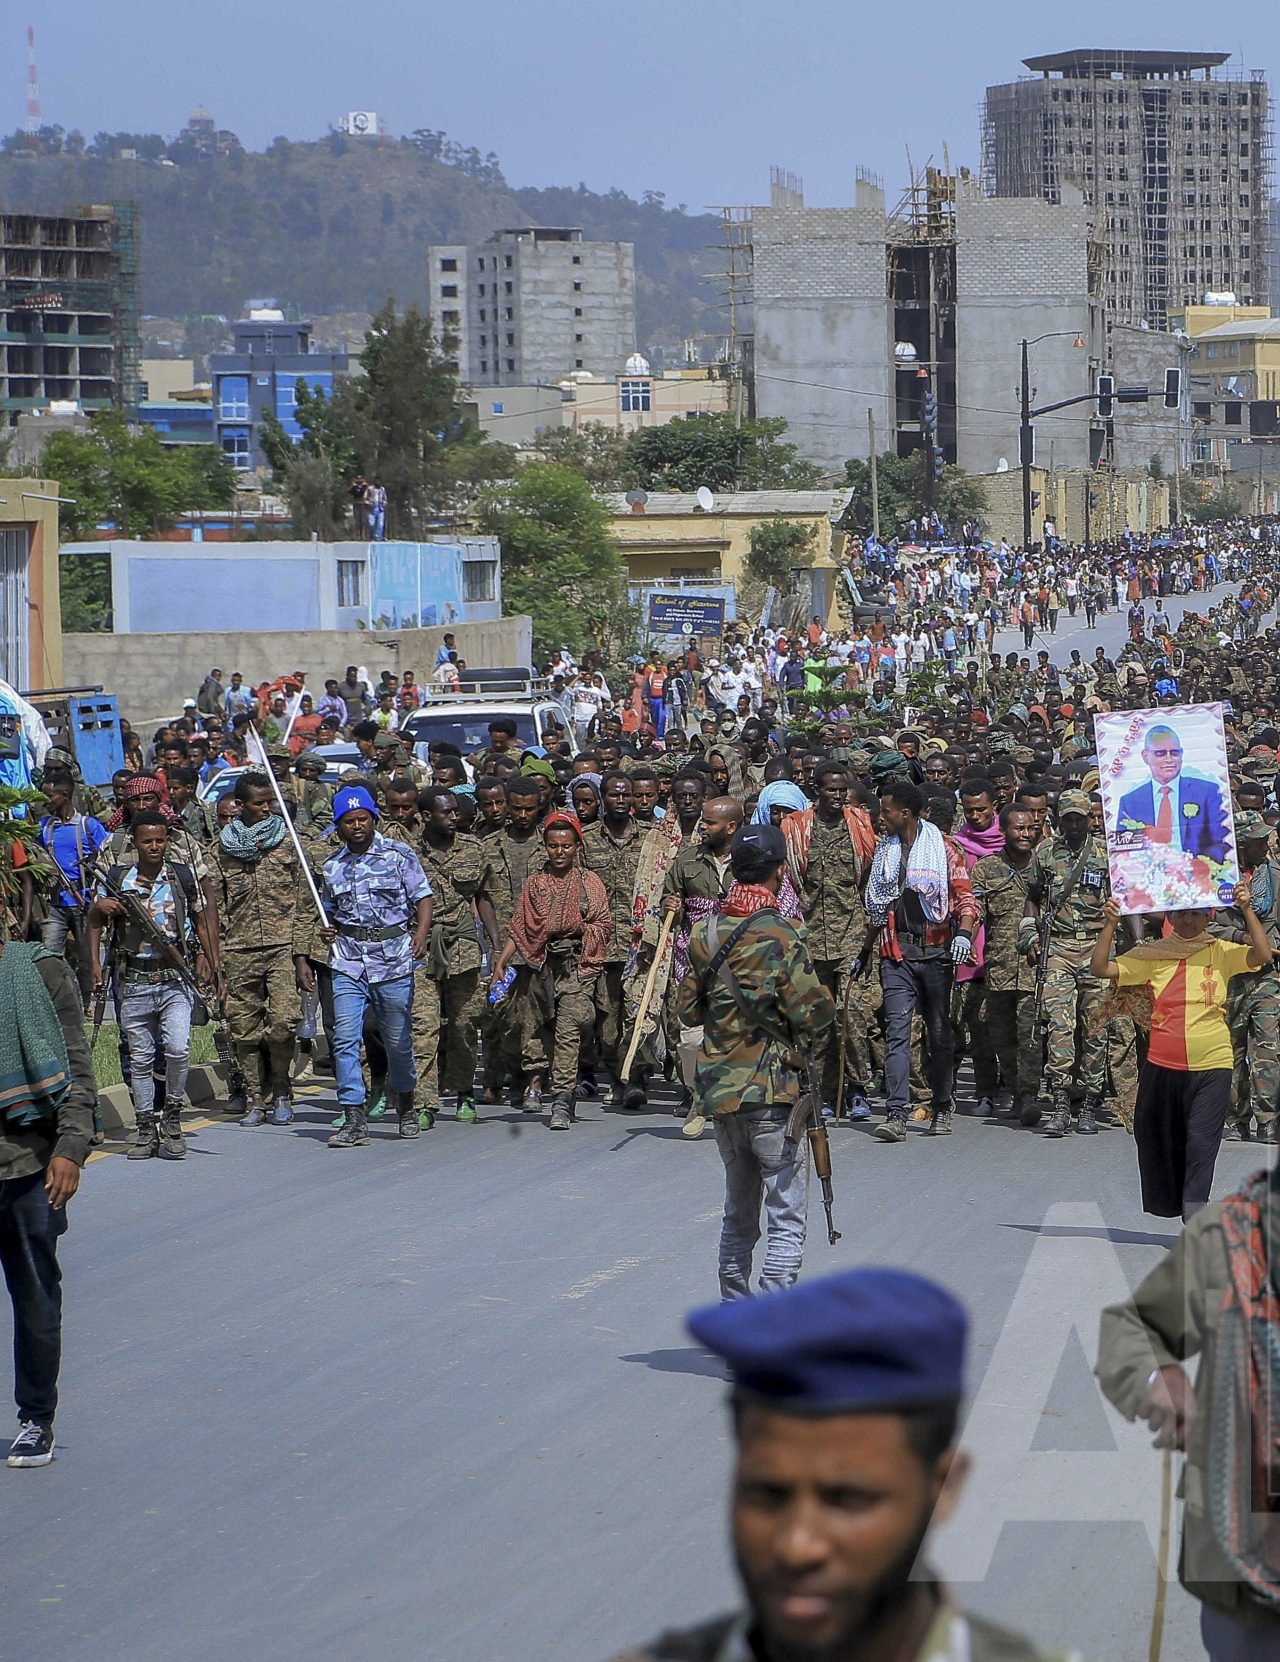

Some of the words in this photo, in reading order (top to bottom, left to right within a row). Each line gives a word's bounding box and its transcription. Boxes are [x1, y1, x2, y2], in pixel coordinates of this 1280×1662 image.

[655, 595, 677, 605] School
[678, 598, 686, 608] of
[347, 797, 361, 809] NY
